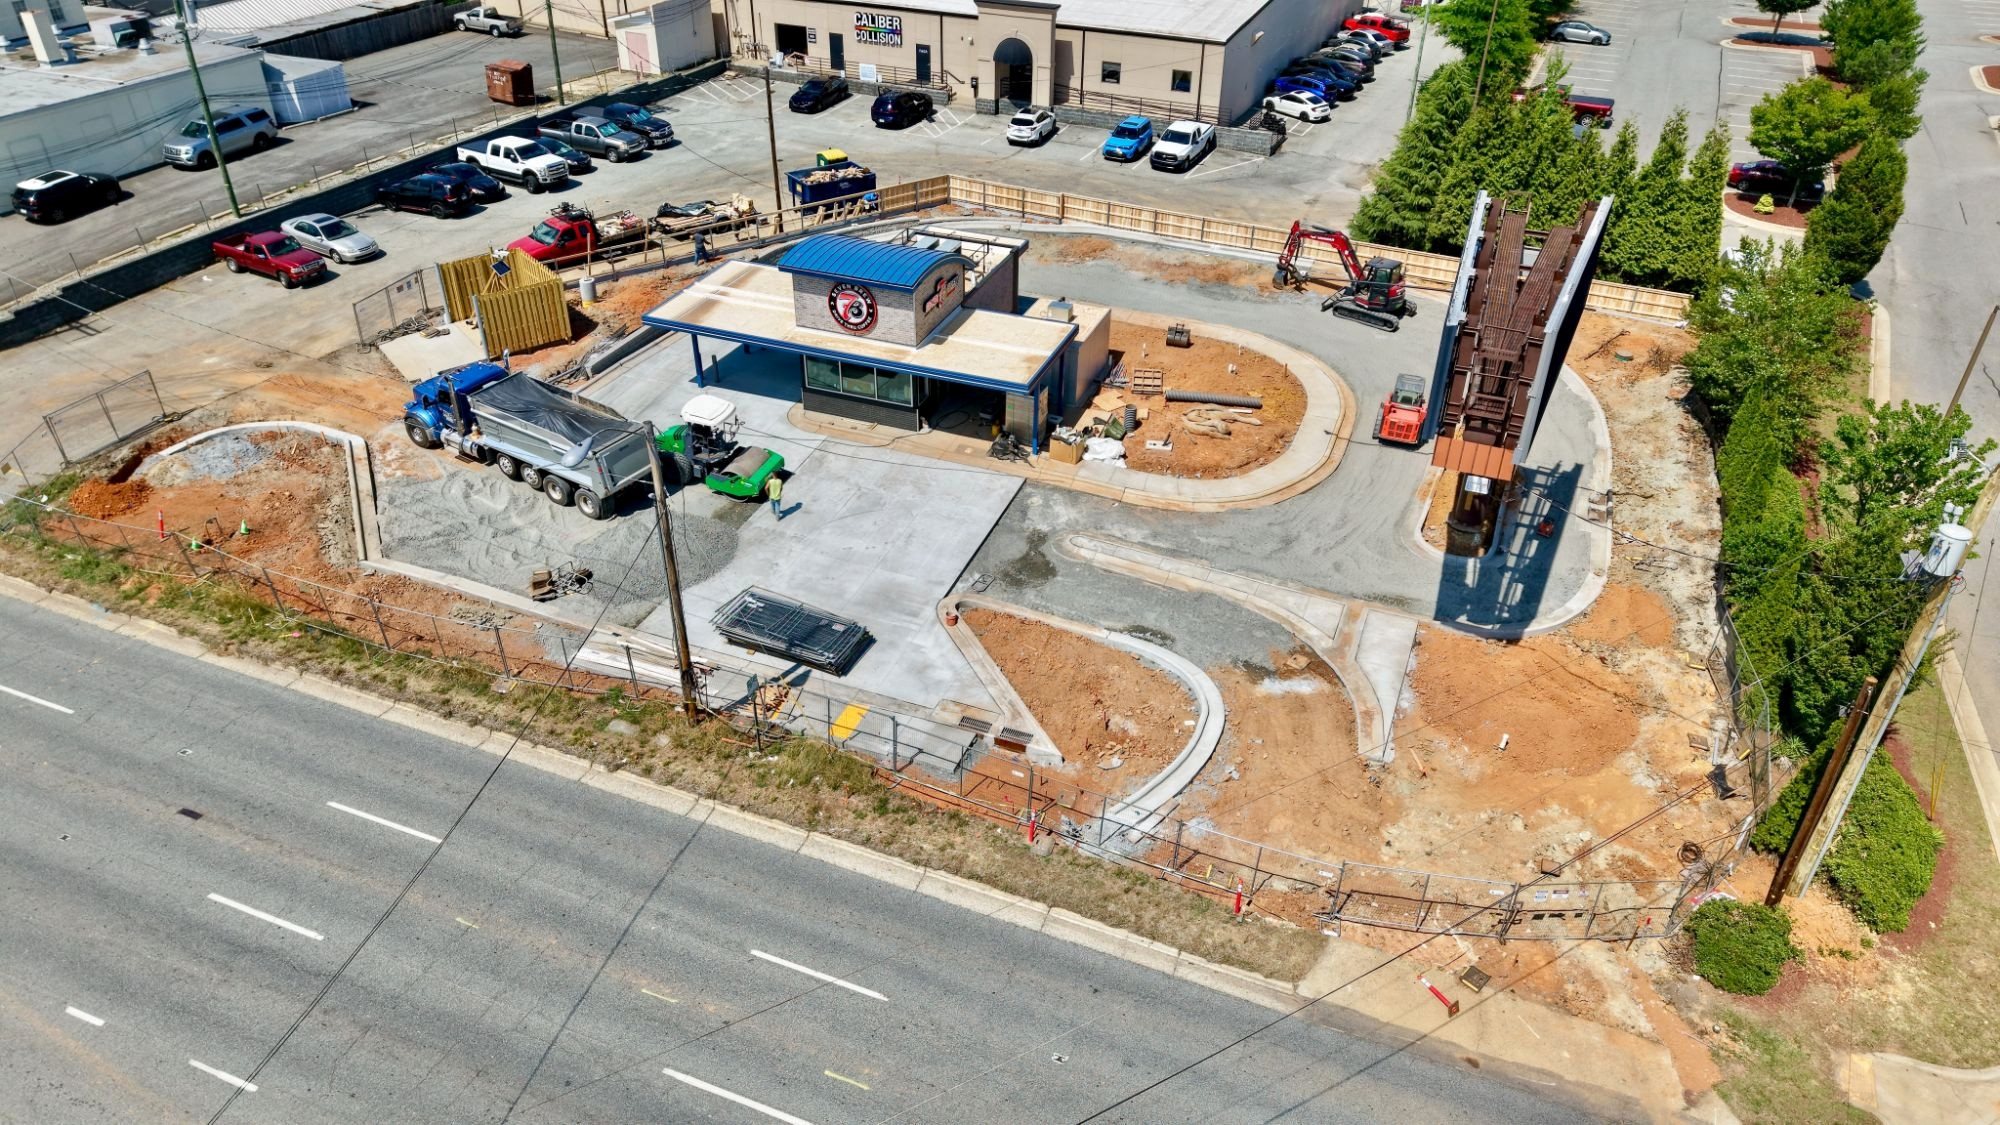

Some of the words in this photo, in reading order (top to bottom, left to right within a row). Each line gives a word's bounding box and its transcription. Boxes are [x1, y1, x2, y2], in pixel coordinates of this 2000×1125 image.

[854, 12, 901, 30] CALIBER
[854, 30, 901, 45] COLLISION
[832, 284, 851, 297] SEVEN
[854, 286, 872, 304] BREW
